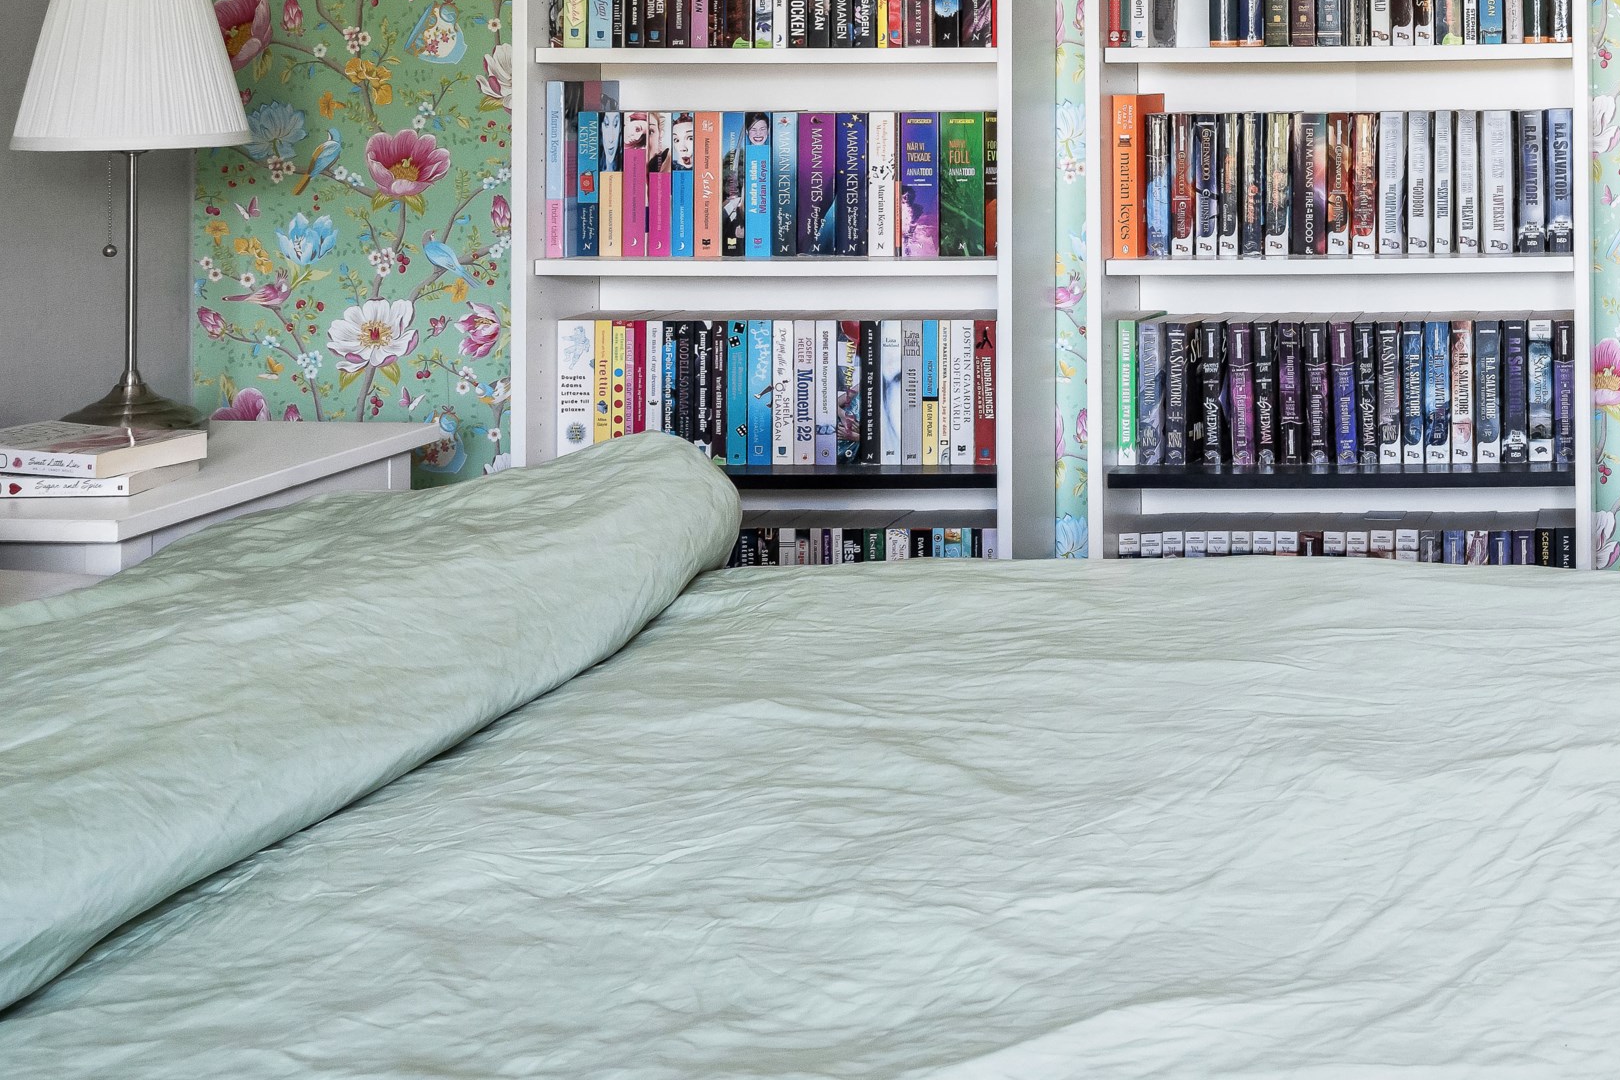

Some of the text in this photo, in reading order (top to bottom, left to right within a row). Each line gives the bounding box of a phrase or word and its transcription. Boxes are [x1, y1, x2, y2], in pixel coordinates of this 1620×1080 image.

[550, 110, 559, 163] Marian Keyes
[579, 126, 588, 155] KEYES
[589, 120, 597, 160] MARIAN
[1306, 149, 1313, 160] M.
[779, 131, 790, 205] MARIAN KEYES
[811, 128, 822, 202] MARIAN KEYES
[847, 130, 858, 204] MARIAN KEYES
[876, 185, 886, 236] Marian Keyes
[1119, 152, 1133, 240] marian keyes
[1413, 186, 1423, 217] GODBORN
[1437, 188, 1448, 218] SENTINEL
[1493, 194, 1504, 232] ADVERSARY
[1462, 205, 1474, 230] REAVER
[599, 360, 609, 397] trettio
[962, 327, 971, 423] JOSTEIN GAARDER
[982, 356, 994, 419] HUNDRAÅRINGEN
[1410, 354, 1420, 417] R.A. SALVATORE
[1459, 353, 1468, 415] R.A. SALVATORE
[1486, 357, 1496, 419] R.A. SALVATORE
[782, 398, 790, 426] SHEILA
[797, 369, 812, 441] Moment 22
[953, 397, 962, 431] VÄRLD
[47, 459, 64, 467] Little
[35, 480, 60, 492] Sugar
[63, 481, 79, 489] and
[853, 544, 861, 552] JO
